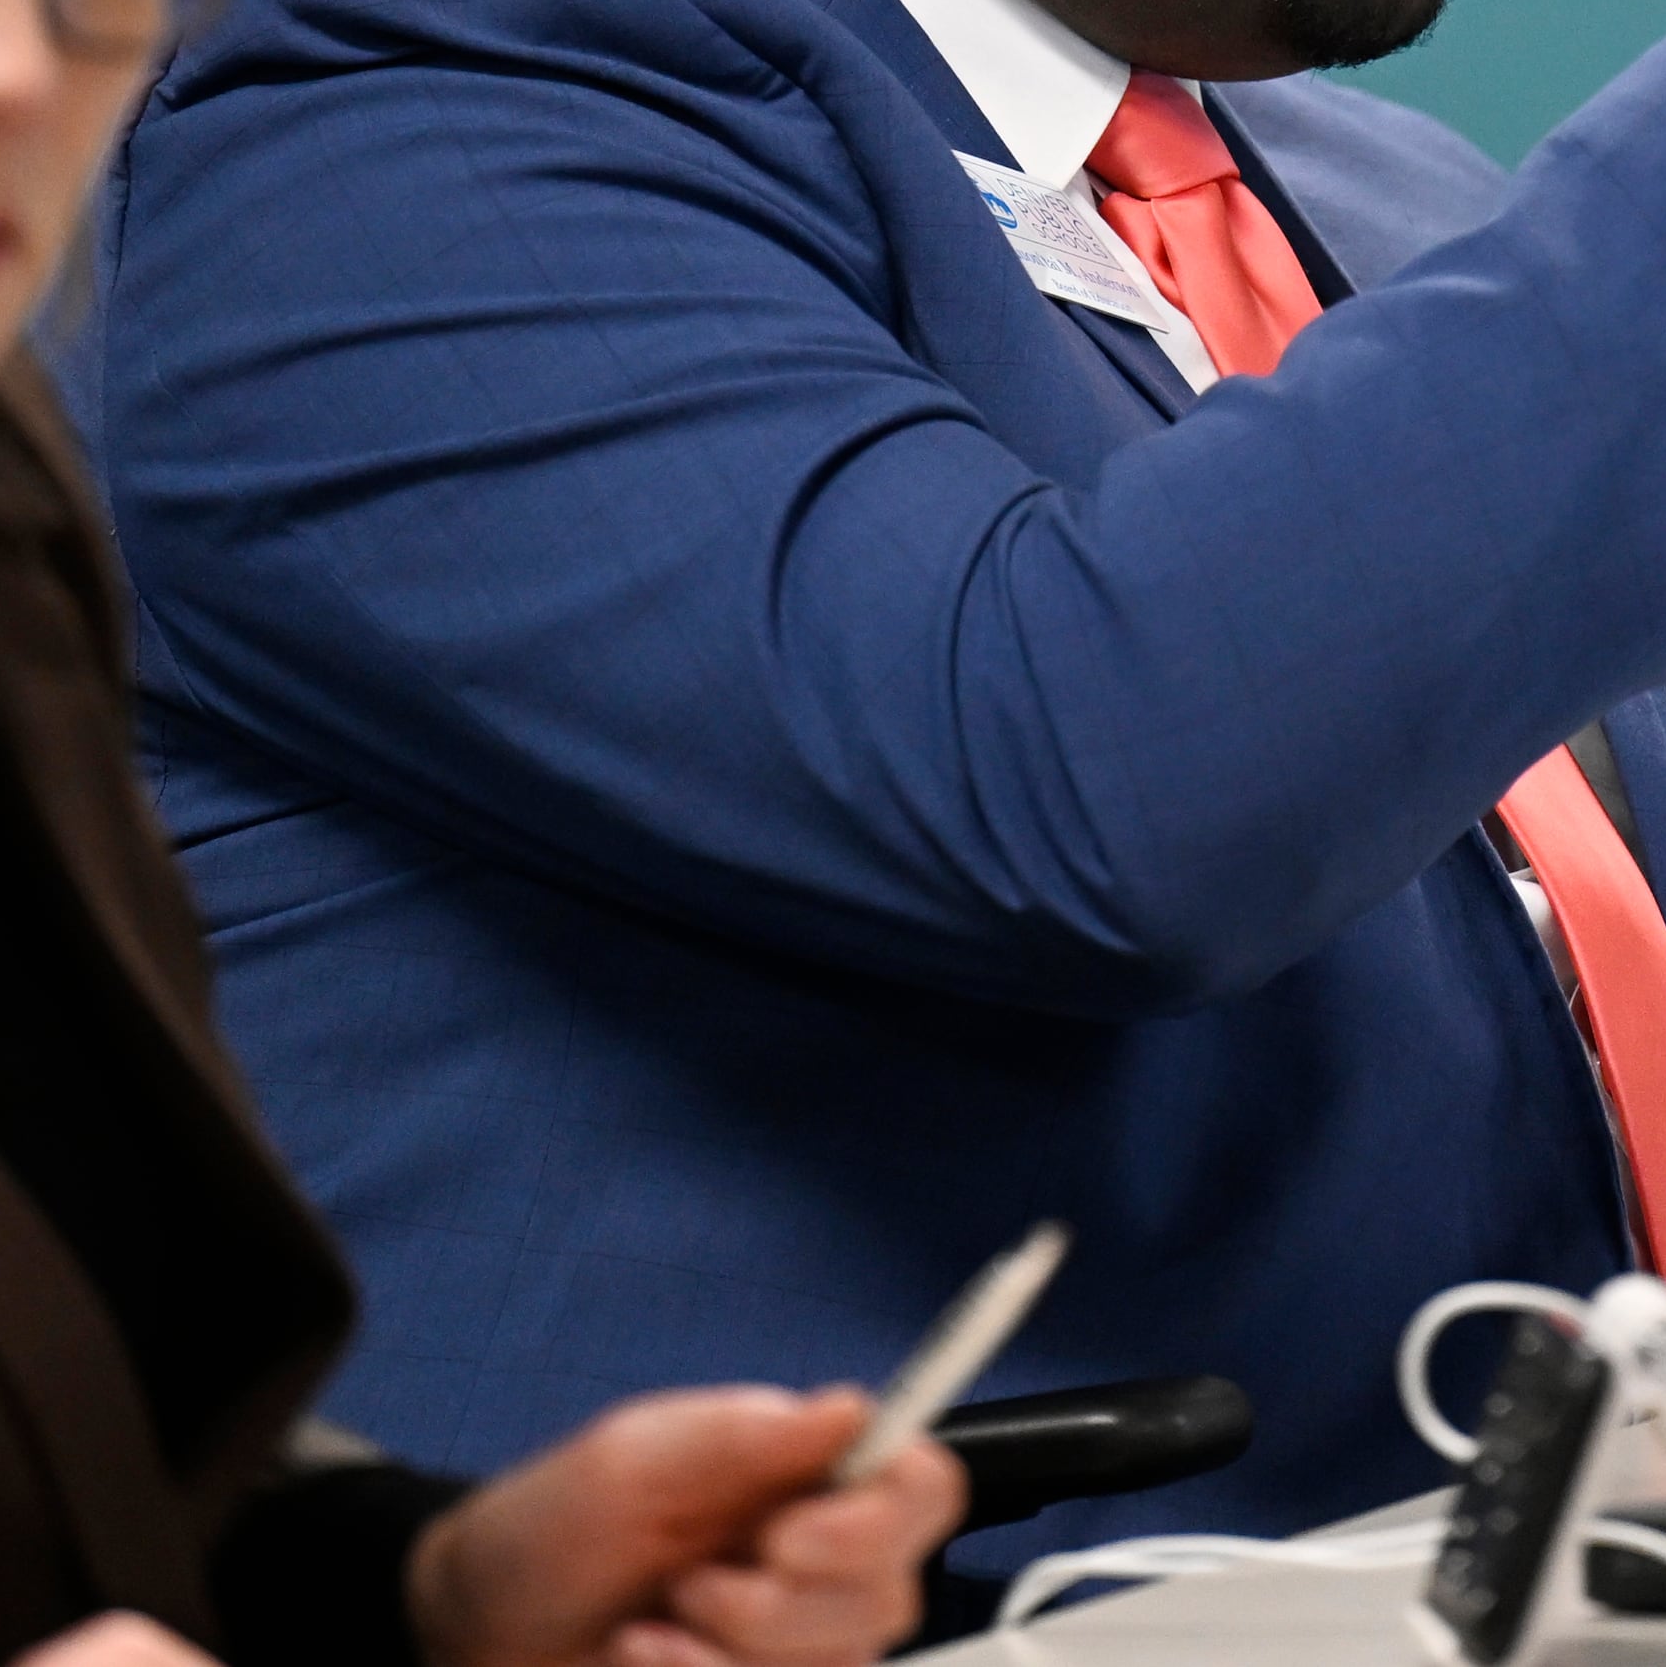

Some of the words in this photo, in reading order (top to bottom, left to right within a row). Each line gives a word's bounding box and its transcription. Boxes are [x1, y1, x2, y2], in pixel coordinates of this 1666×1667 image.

[997, 178, 1076, 218] DENVER
[1013, 199, 1093, 240] PUBLIC
[1032, 223, 1108, 259] SCHOOLS
